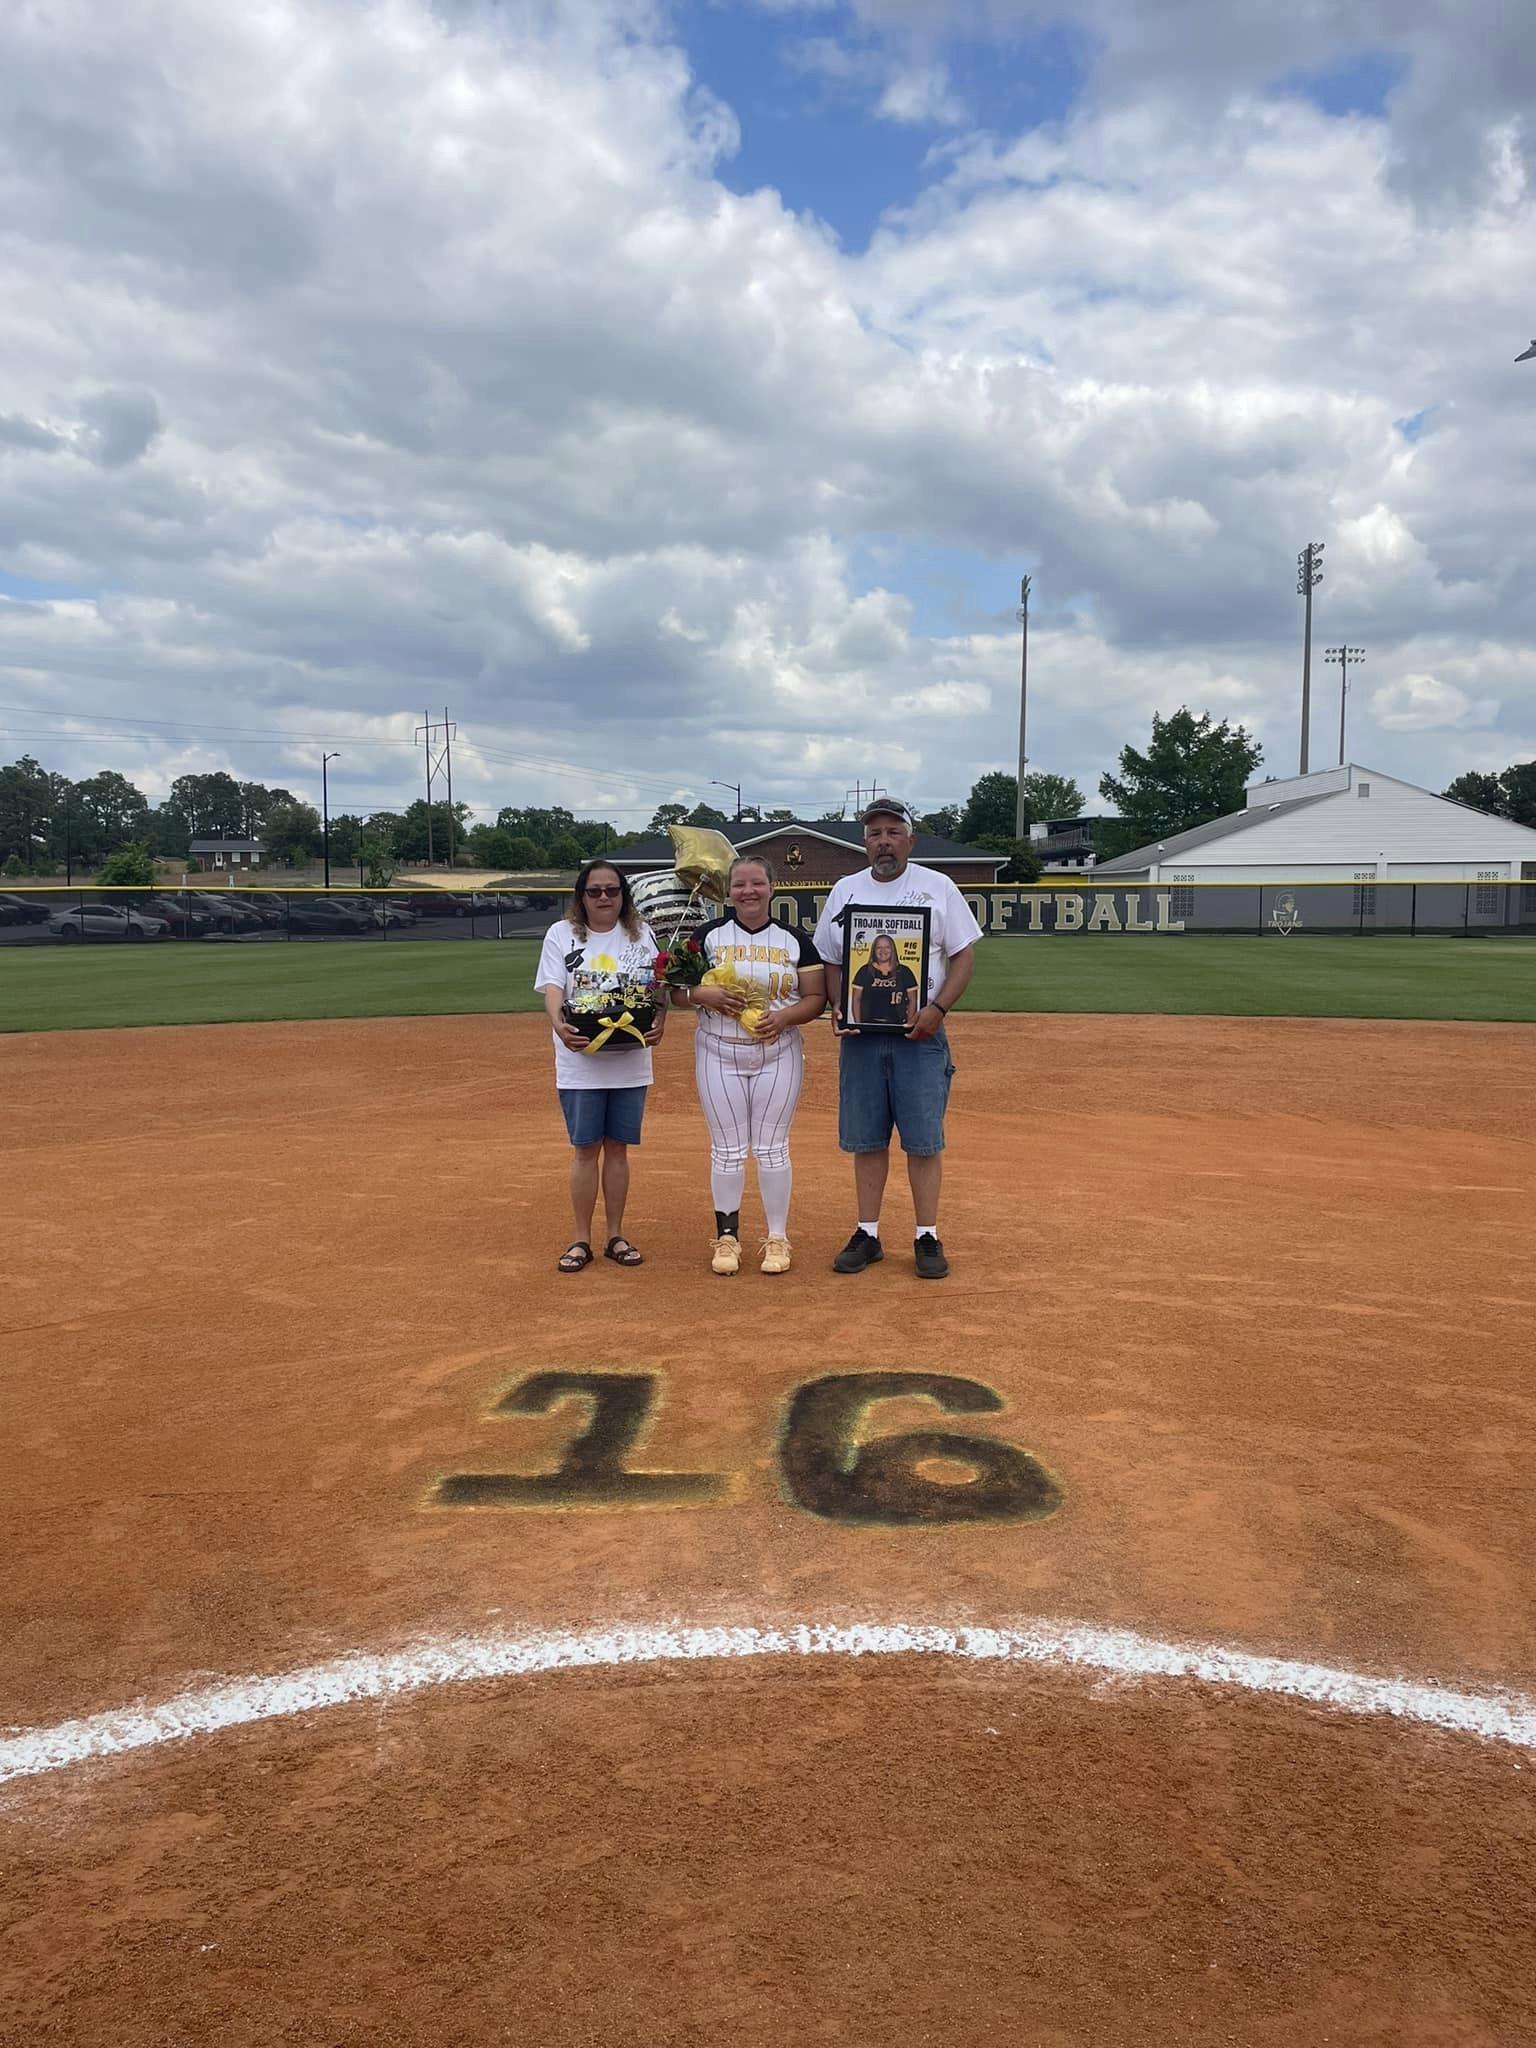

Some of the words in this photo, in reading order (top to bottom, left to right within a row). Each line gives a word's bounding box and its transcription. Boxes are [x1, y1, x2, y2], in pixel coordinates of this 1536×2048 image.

[853, 918, 883, 928] TROJAN
[885, 919, 922, 930] SOFTBALL
[967, 894, 1185, 931] OFTBALL
[1267, 920, 1304, 928] TROJANS
[714, 944, 792, 967] TROJANS
[768, 972, 794, 1000] 16
[890, 991, 904, 1005] 16
[424, 1369, 1064, 1524] 16
